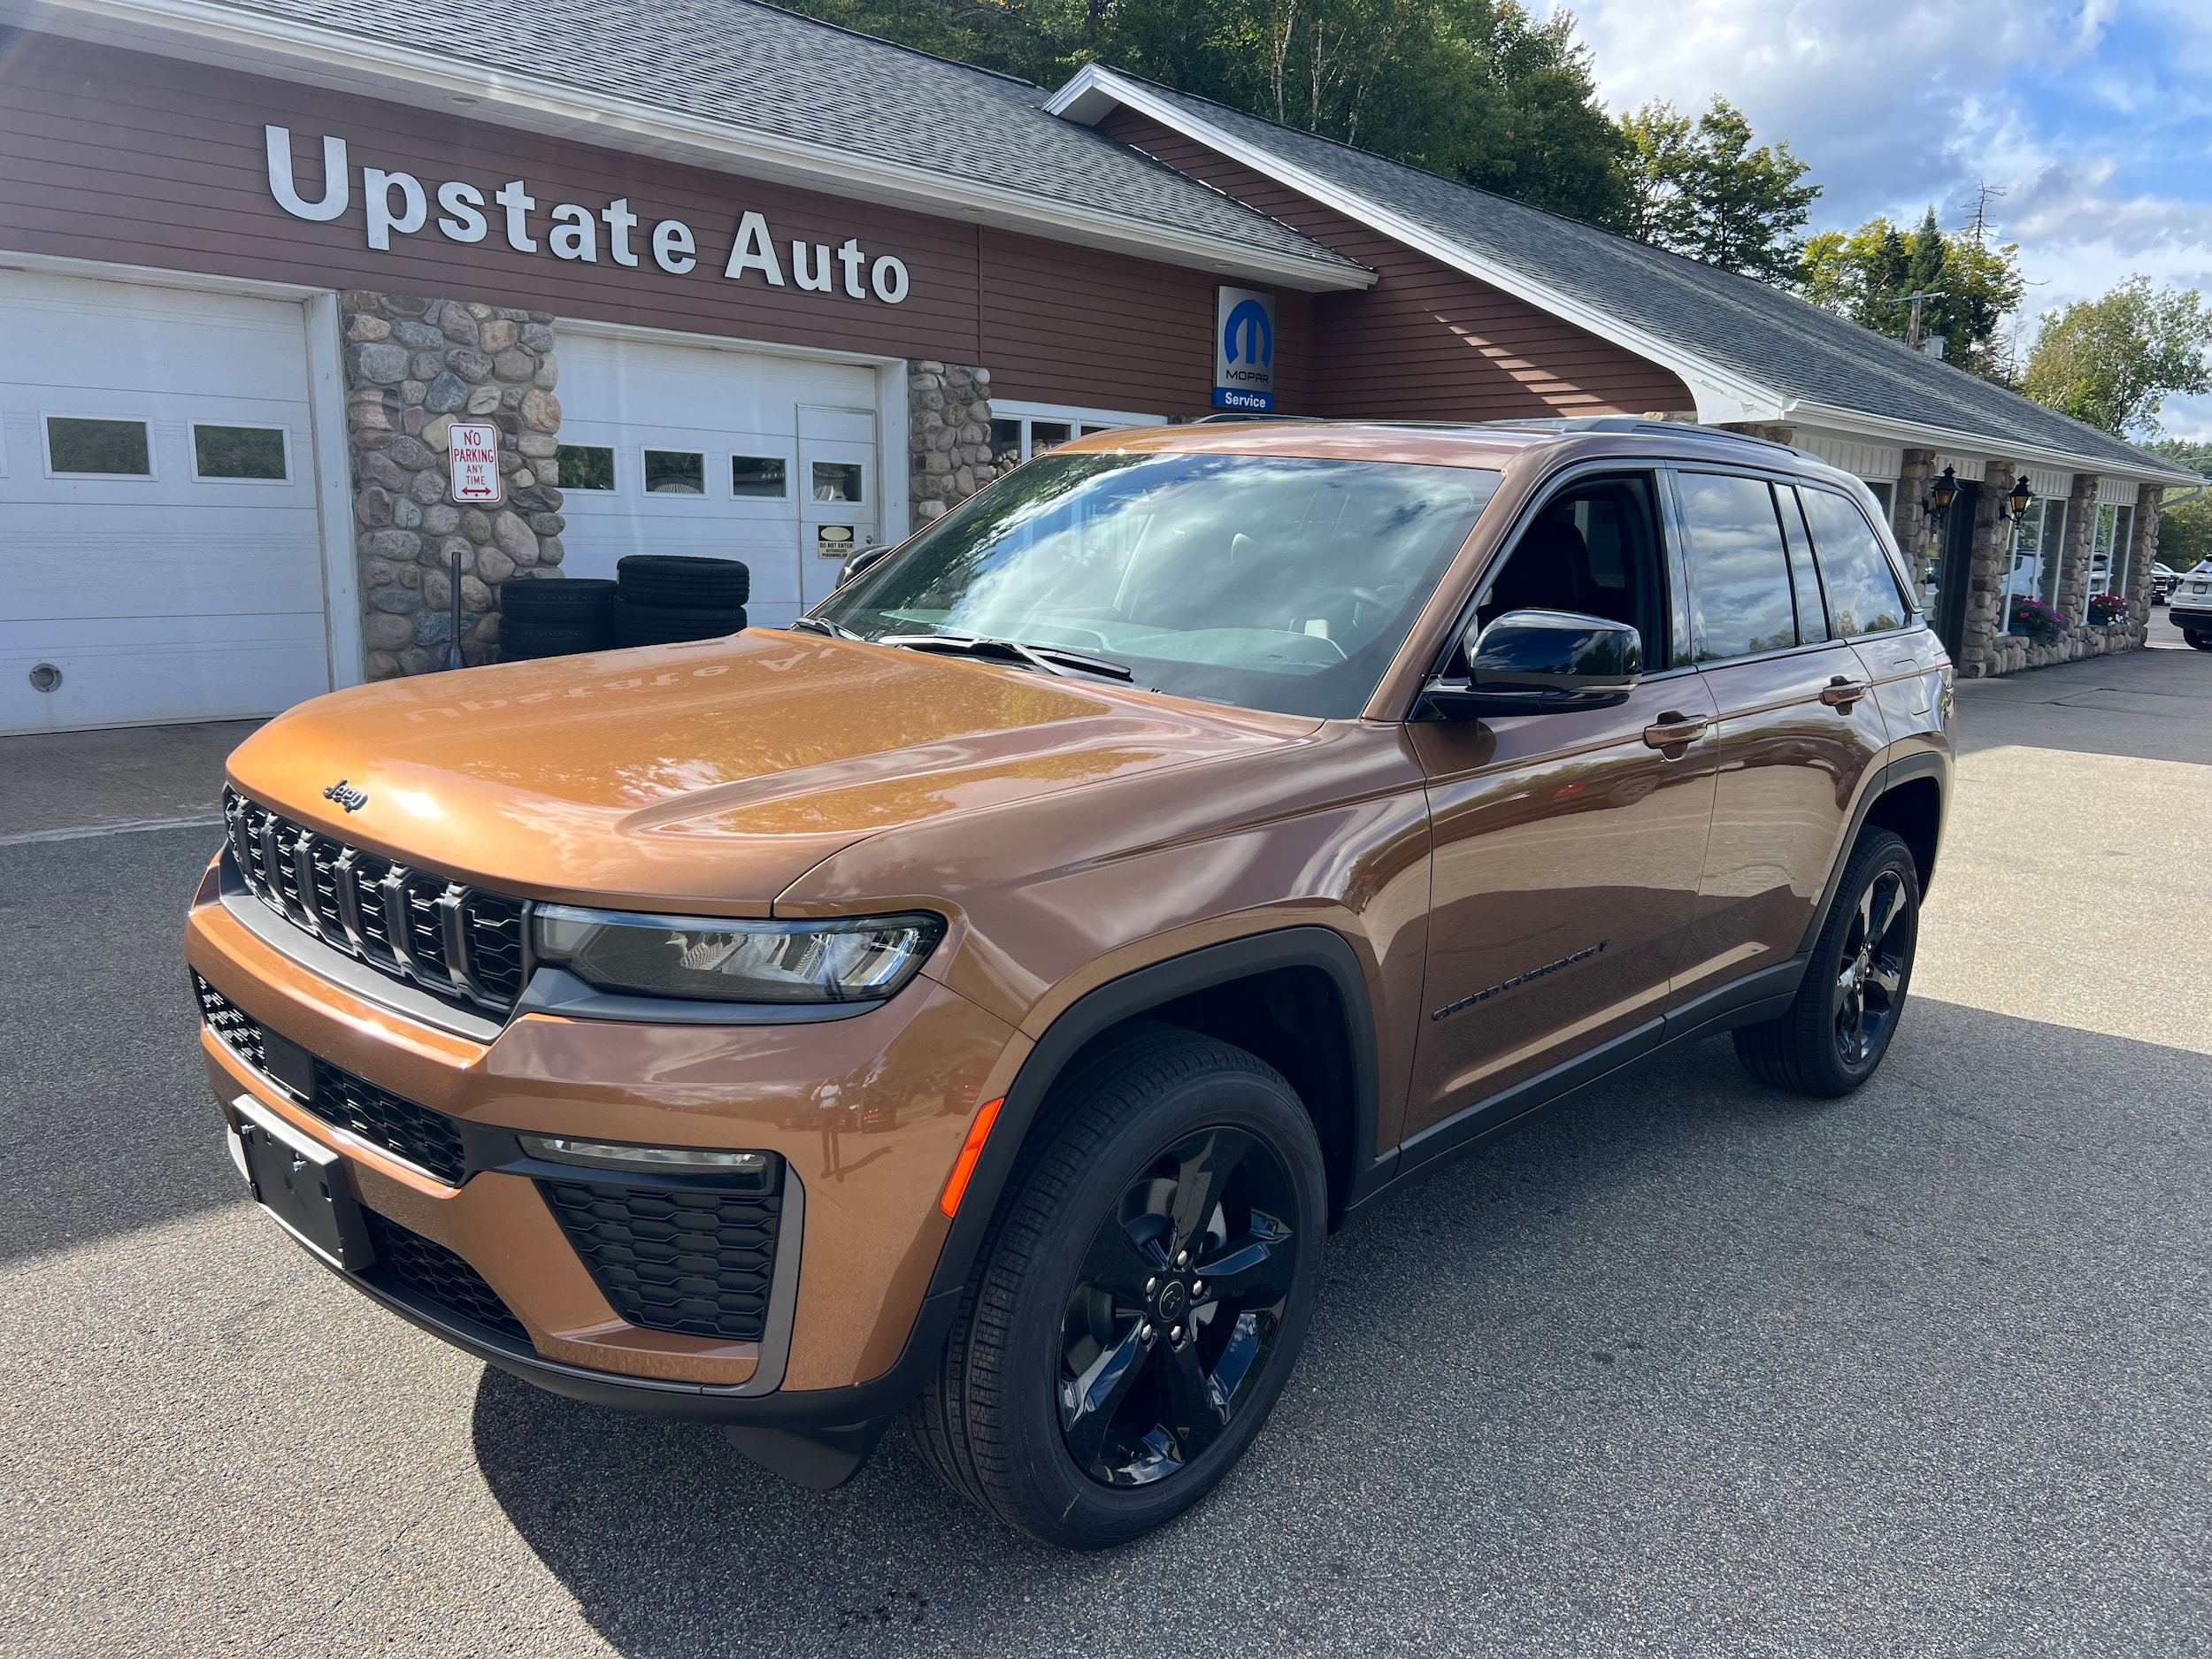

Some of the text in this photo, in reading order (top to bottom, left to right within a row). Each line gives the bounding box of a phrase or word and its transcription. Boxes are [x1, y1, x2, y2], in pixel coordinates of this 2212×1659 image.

[265, 124, 910, 304] Upstate Auto
[1225, 369, 1270, 384] MOPAR
[1225, 391, 1266, 409] Service
[464, 431, 481, 446] NO
[454, 449, 494, 463] PARKING
[466, 465, 484, 474] ANY
[465, 475, 487, 486] TIME
[323, 779, 368, 813] Jeep
